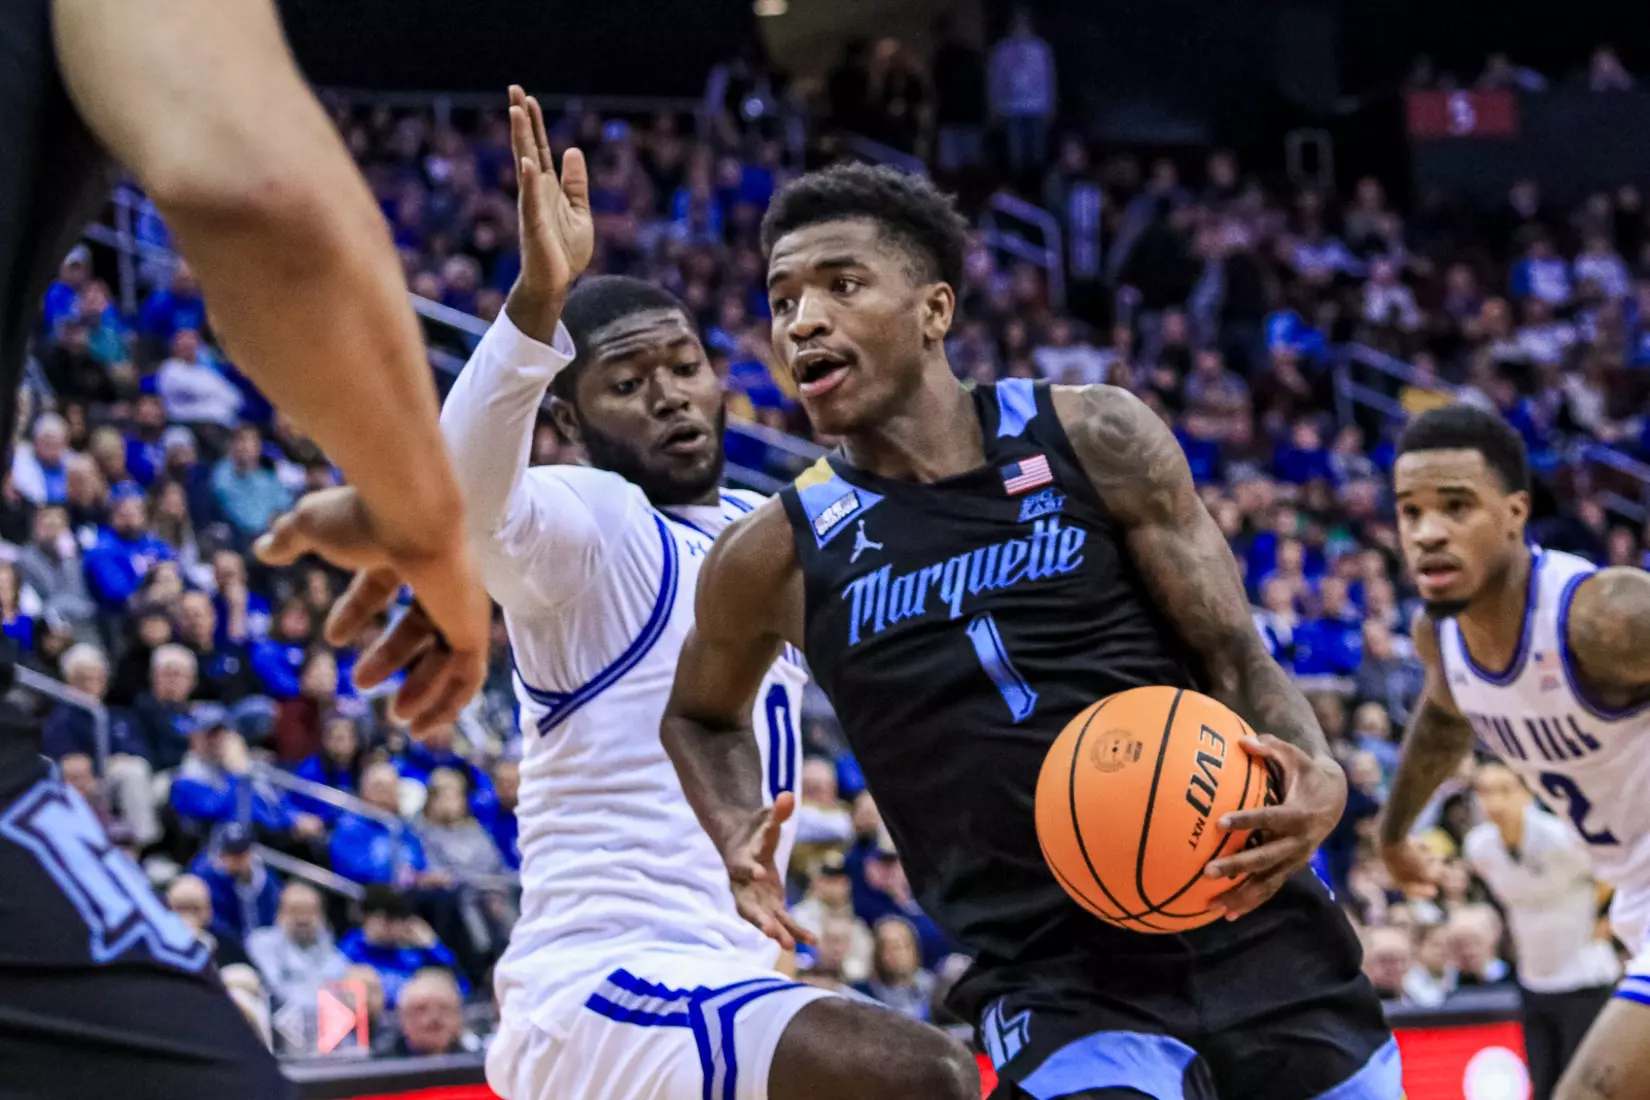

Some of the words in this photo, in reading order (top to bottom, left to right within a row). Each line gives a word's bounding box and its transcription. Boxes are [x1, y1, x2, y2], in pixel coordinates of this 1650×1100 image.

[841, 516, 1087, 646] Marquette
[965, 611, 1039, 724] 1
[765, 683, 796, 801] 0
[1188, 816, 1207, 852] NXT
[1540, 771, 1621, 846] 2
